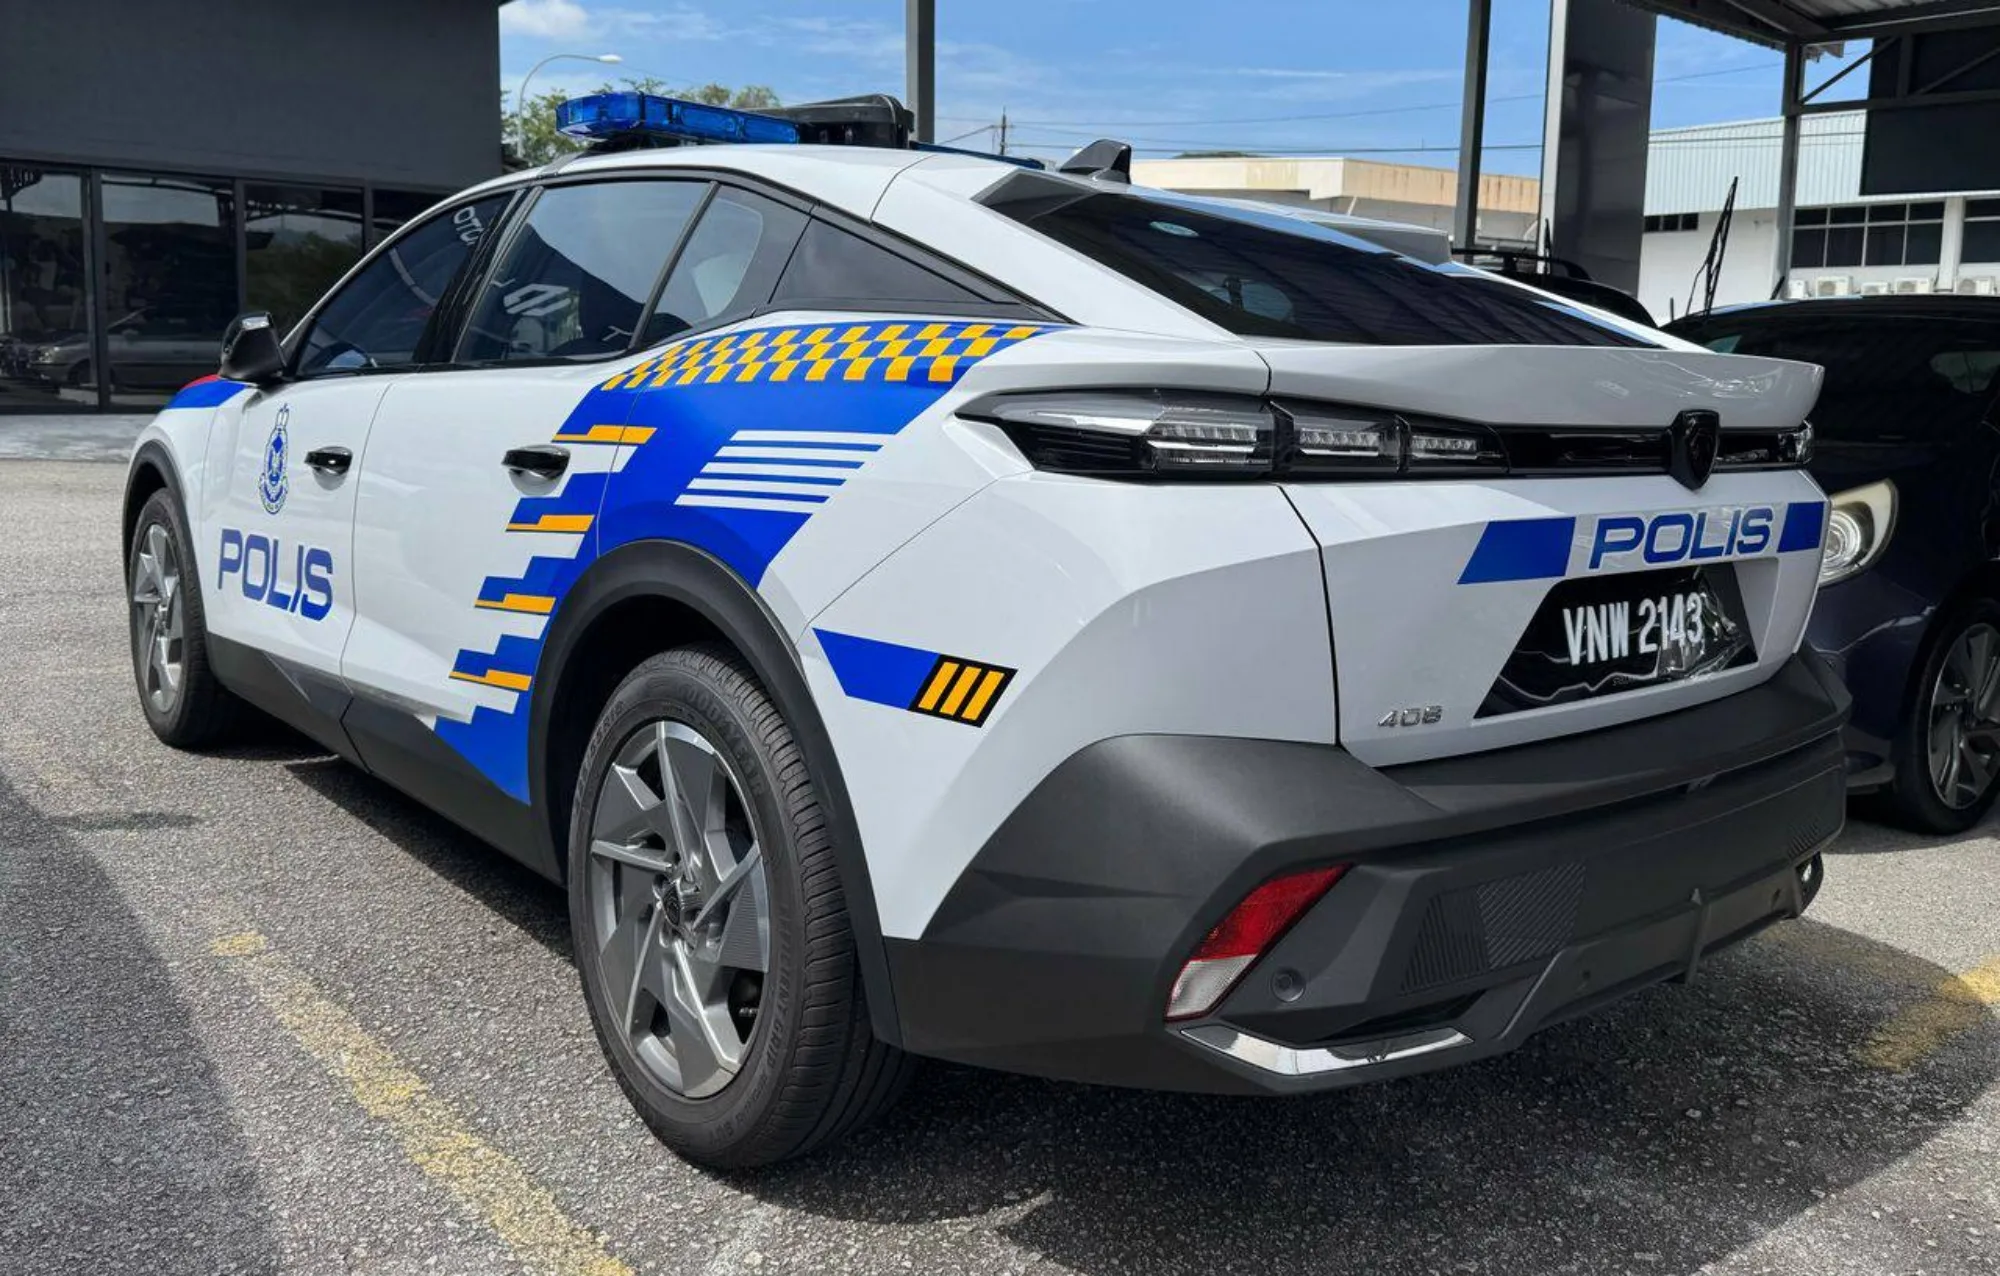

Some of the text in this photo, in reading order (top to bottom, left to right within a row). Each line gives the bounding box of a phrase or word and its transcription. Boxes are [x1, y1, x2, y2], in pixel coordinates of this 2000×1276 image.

[1588, 508, 1774, 570] POLIS
[217, 528, 334, 622] POLIS
[1562, 591, 1703, 666] VNW 2143
[1377, 705, 1443, 727] 408
